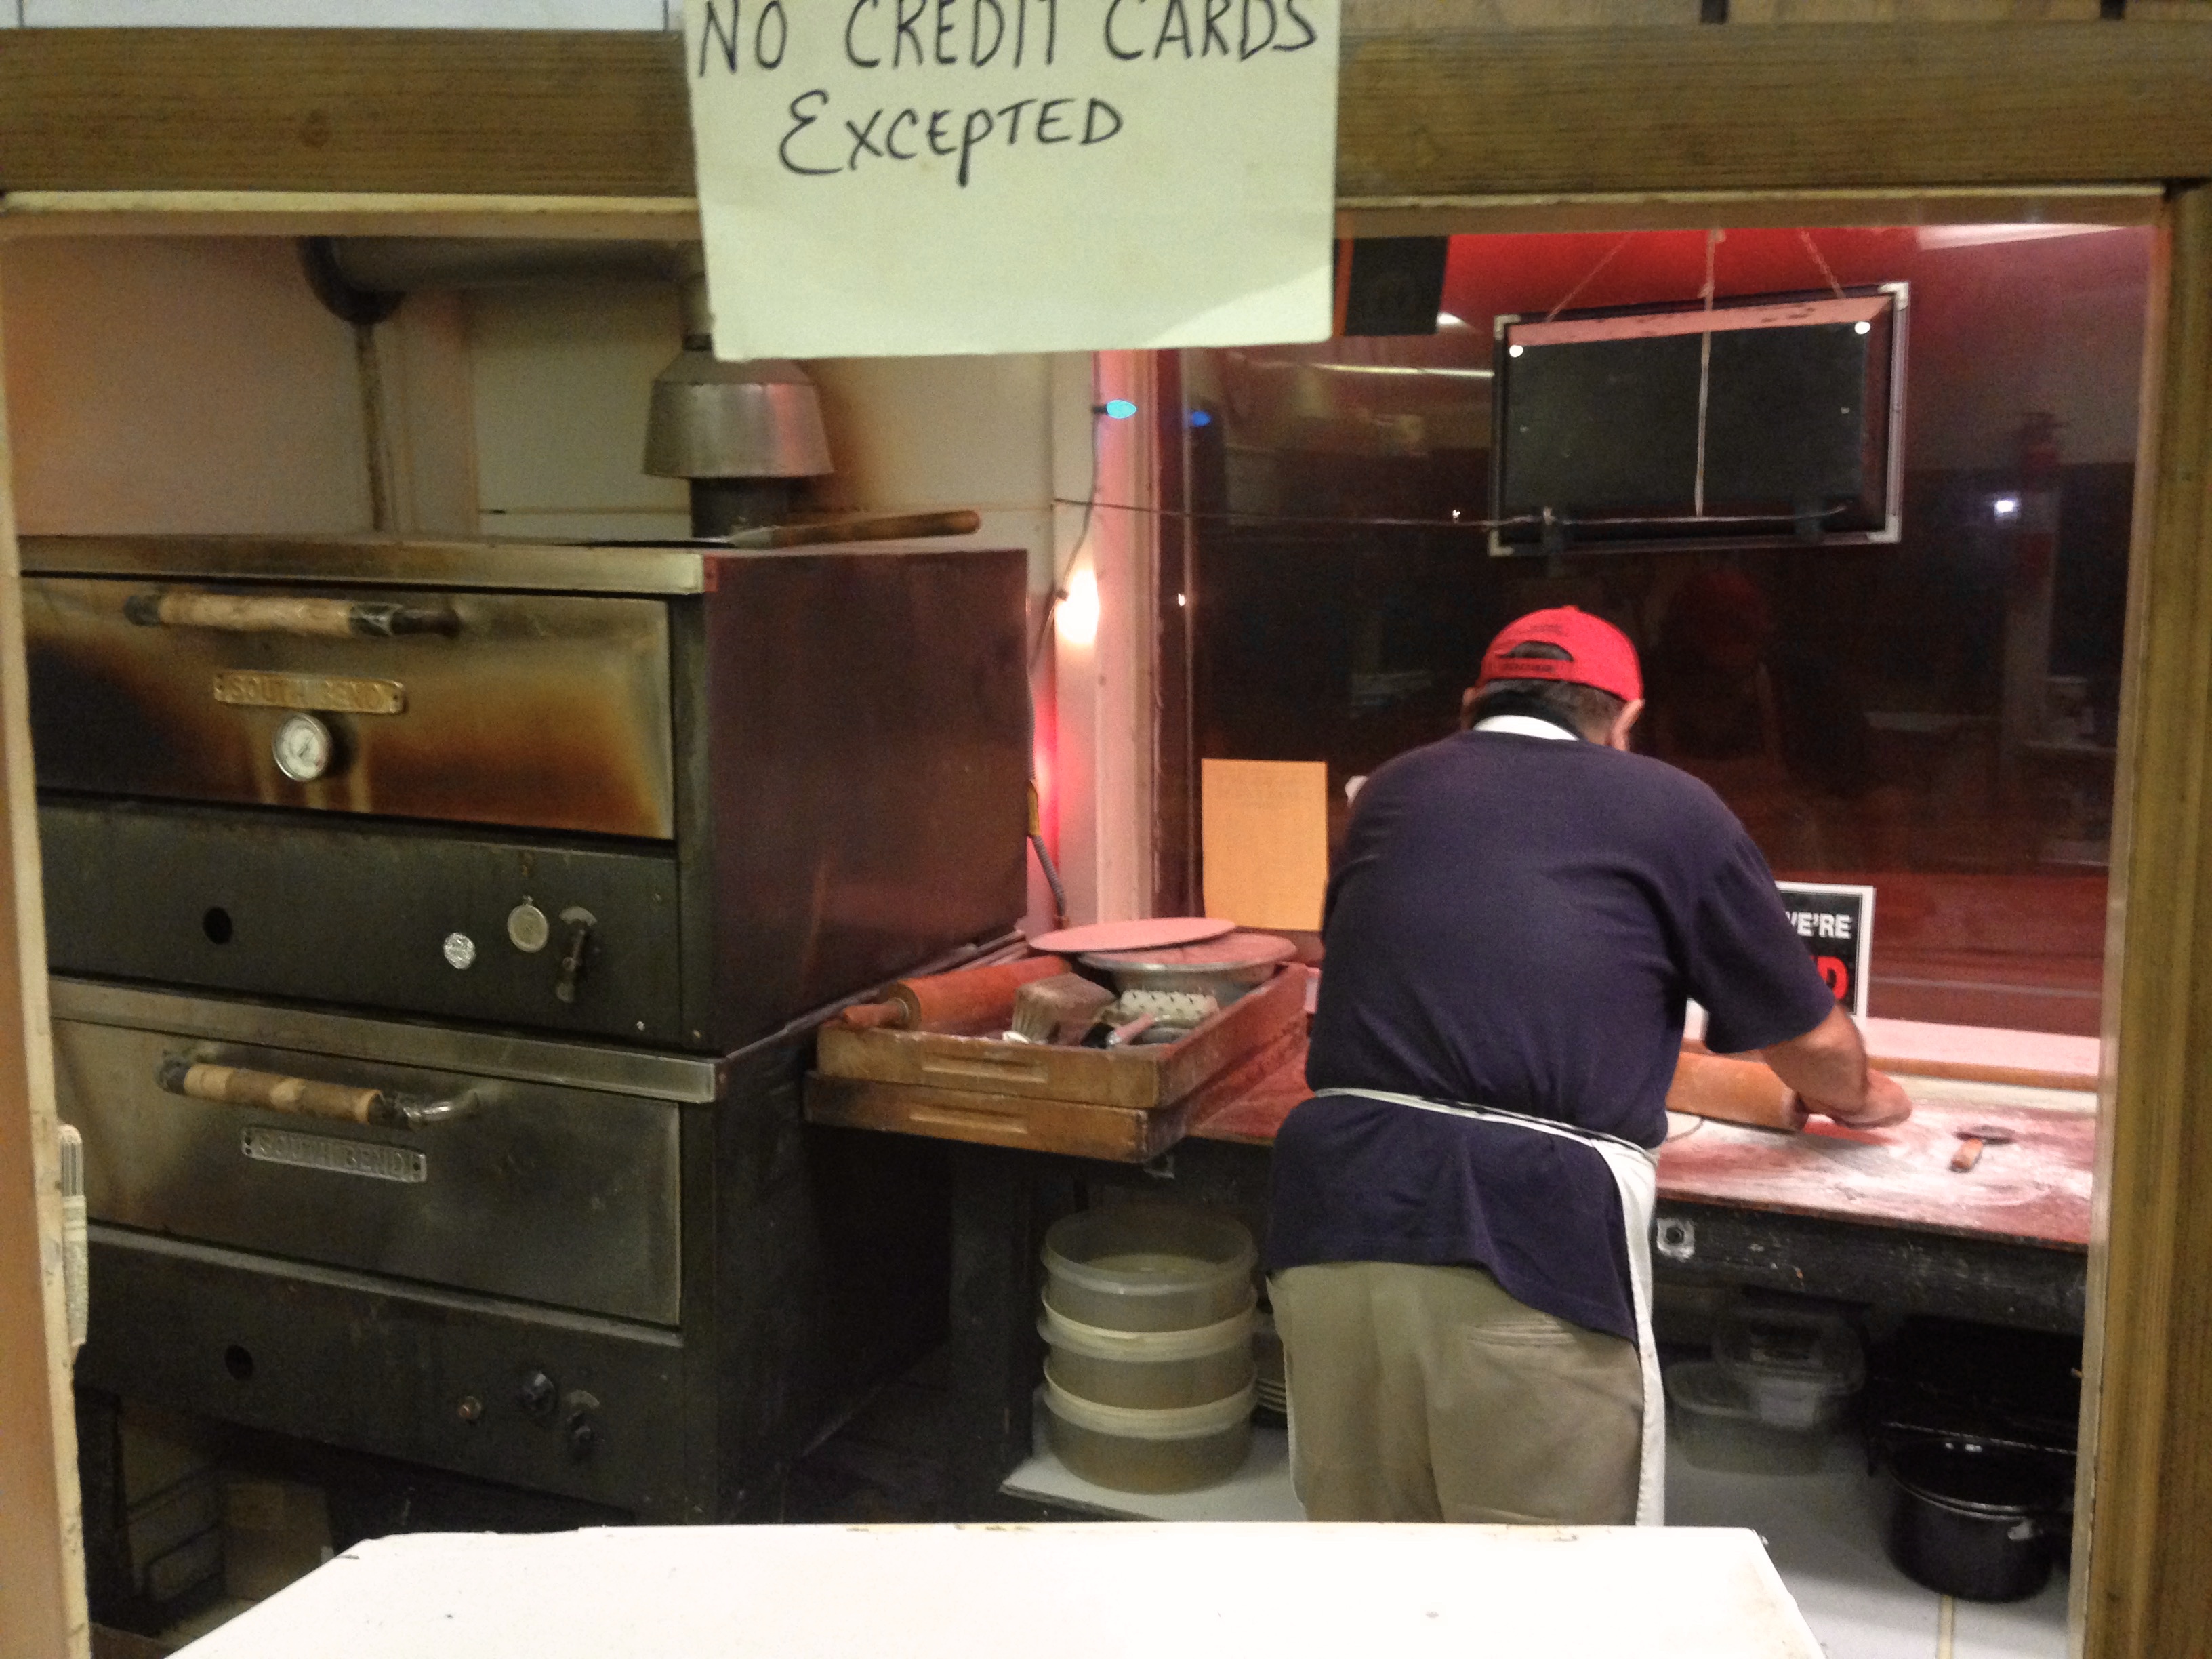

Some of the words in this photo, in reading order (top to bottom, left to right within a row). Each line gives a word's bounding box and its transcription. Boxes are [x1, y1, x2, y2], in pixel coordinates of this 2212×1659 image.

[699, 0, 787, 77] NO
[845, 0, 1057, 68] CREDIT
[1103, 0, 1317, 61] CARDS
[779, 89, 1124, 188] EXCEPTED
